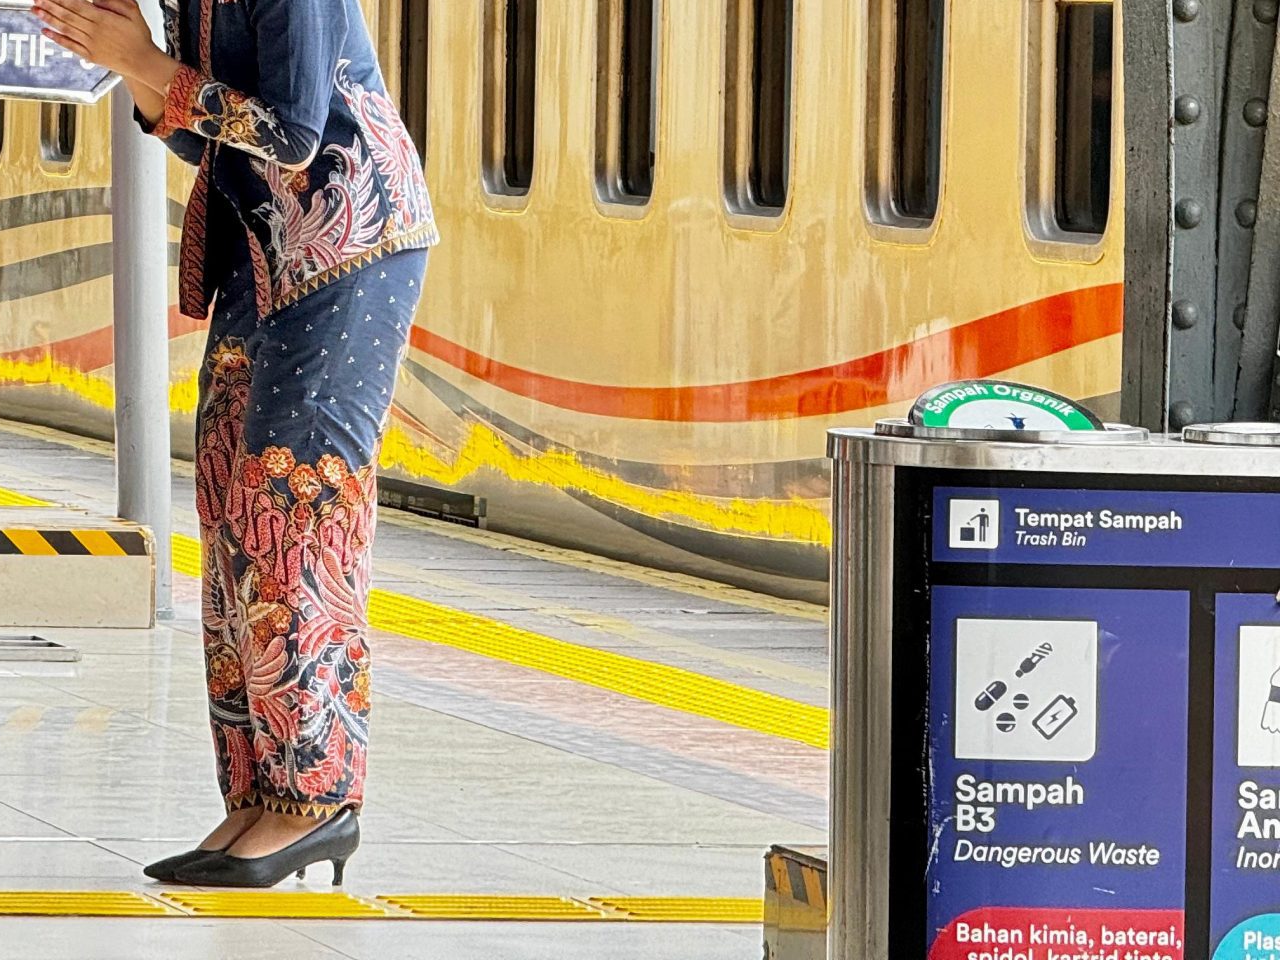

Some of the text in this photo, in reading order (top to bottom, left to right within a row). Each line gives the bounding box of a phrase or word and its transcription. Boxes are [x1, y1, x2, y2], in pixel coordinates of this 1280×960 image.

[925, 383, 1076, 417] Sampah Organik
[1015, 509, 1183, 533] Tempat Sampah
[1016, 530, 1087, 547] Trash Bin
[956, 774, 1084, 811] Sampah
[955, 805, 995, 832] B3
[953, 839, 1161, 866] Dangerous Waste
[956, 922, 1182, 950] Bahan kimia, baterai,
